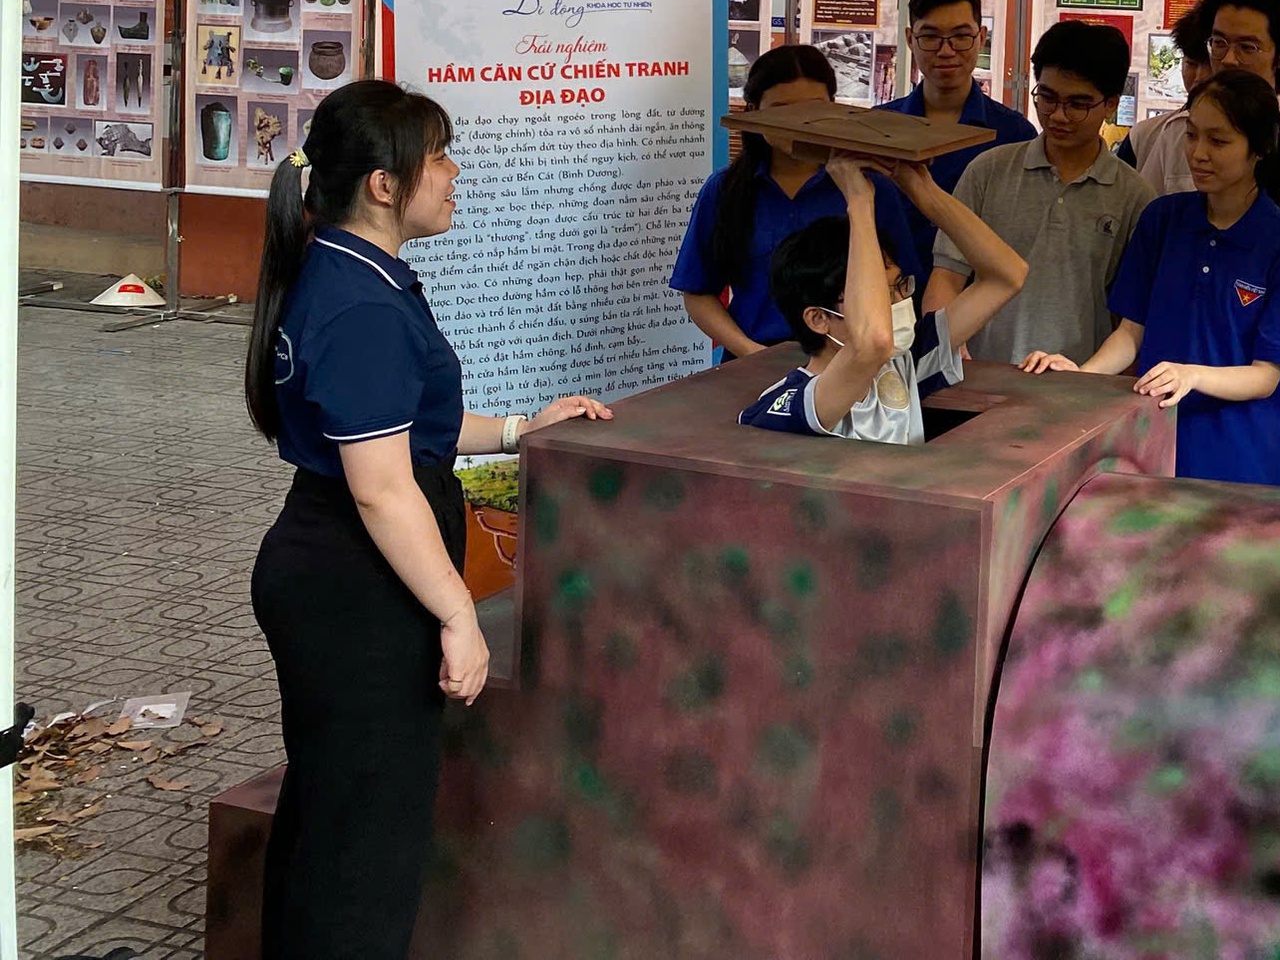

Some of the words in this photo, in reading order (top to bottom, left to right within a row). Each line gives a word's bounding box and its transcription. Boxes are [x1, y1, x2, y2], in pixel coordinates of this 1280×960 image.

[428, 63, 475, 83] HẦM
[480, 63, 522, 82] CĂN
[527, 63, 556, 81] CỨ
[560, 58, 620, 80] CHIẾN
[625, 61, 689, 77] TRANH
[519, 90, 556, 109] ĐỊA
[560, 87, 605, 108] ĐẠO
[460, 161, 475, 170] Sài
[478, 160, 500, 170] Gòn,
[504, 157, 516, 167] để
[520, 157, 534, 166] khi
[538, 156, 547, 168] bị
[550, 155, 569, 165] tình
[573, 153, 588, 163] thế
[592, 156, 614, 165] nguy
[618, 151, 638, 163] kịch,
[641, 151, 651, 159] có
[690, 150, 705, 159] qua
[455, 176, 478, 187] vùng
[502, 174, 513, 182] cứ
[517, 172, 534, 182] Bến
[538, 172, 554, 181] Cát
[558, 170, 583, 182] (Bình
[587, 168, 624, 181] Dương).
